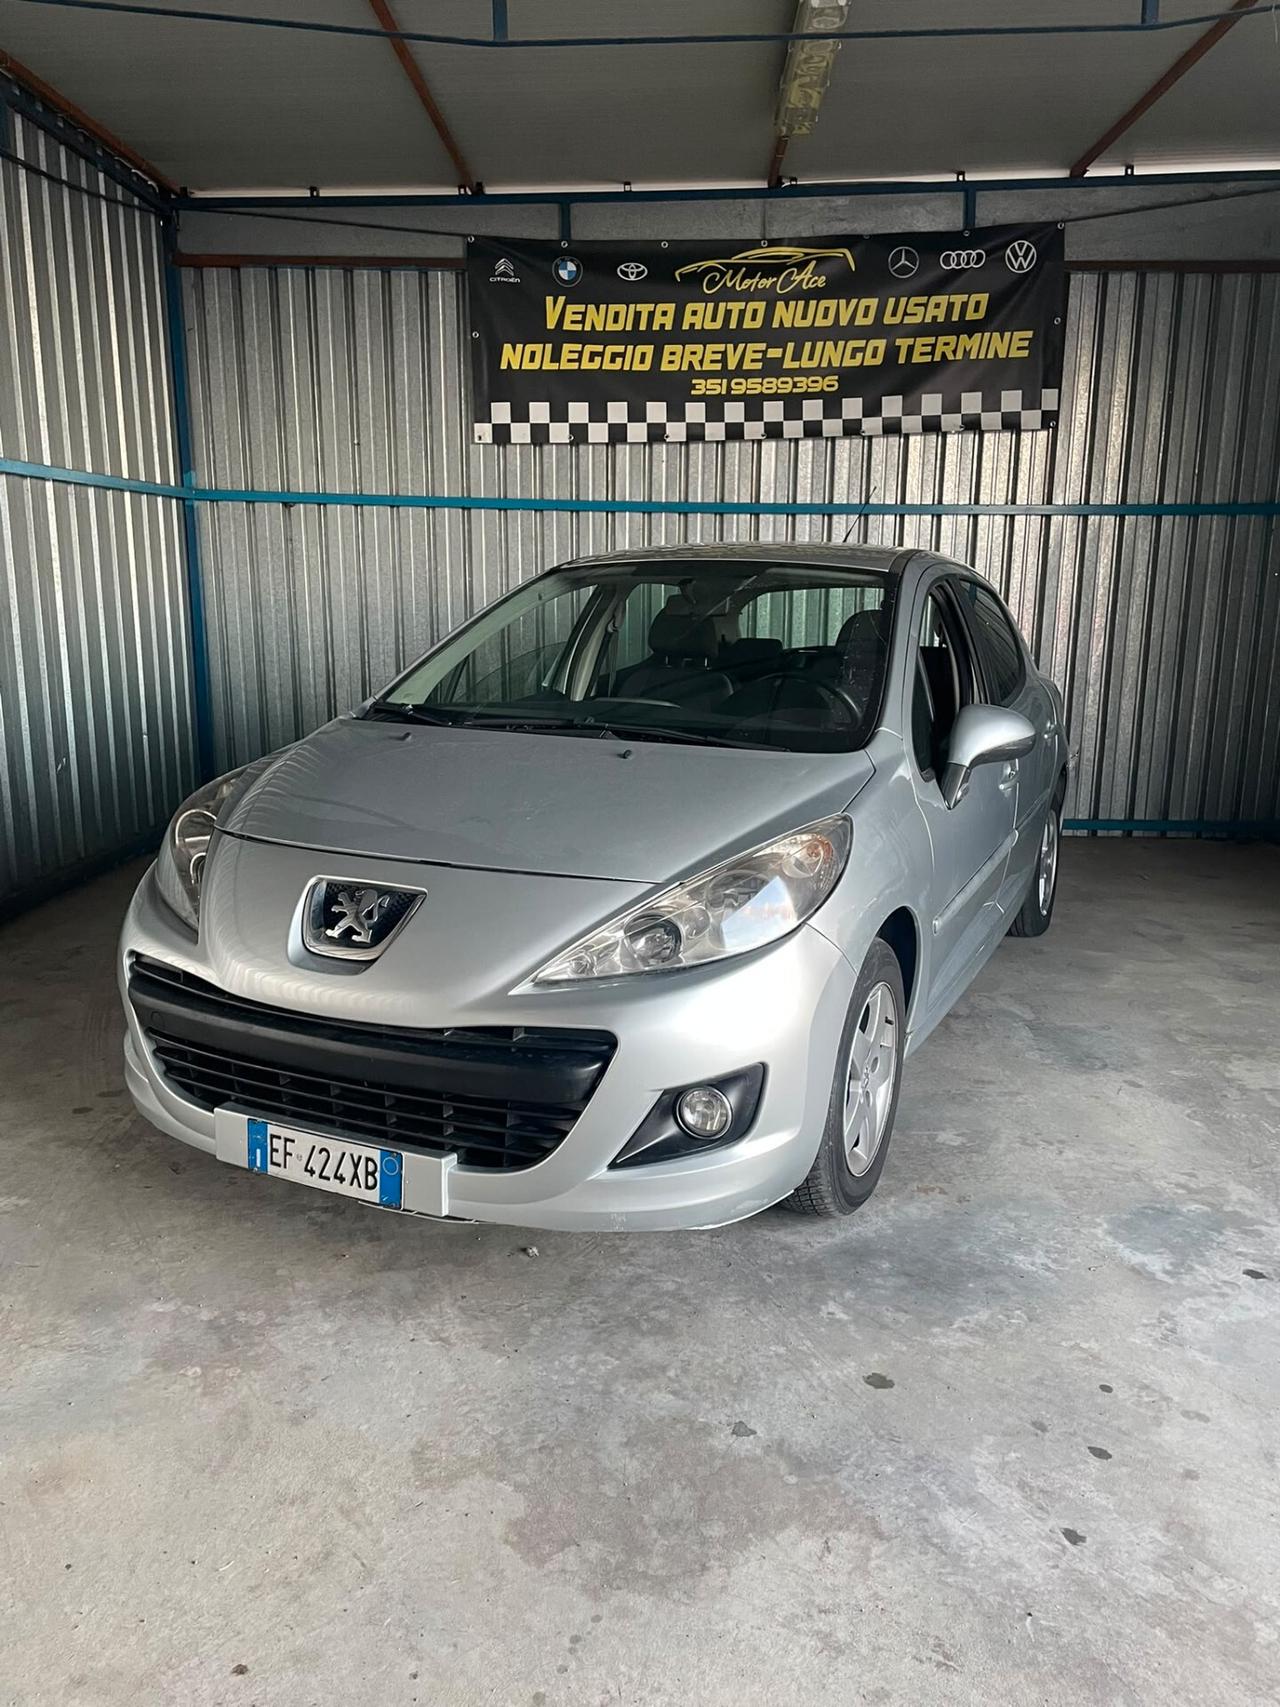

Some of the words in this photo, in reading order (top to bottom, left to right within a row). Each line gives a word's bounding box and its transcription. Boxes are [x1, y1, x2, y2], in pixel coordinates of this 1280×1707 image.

[702, 266, 777, 294] Motor
[776, 260, 827, 294] Ace
[545, 296, 676, 331] VENDITA
[682, 301, 766, 330] AUTO
[772, 298, 879, 329] NUOVO
[883, 293, 989, 325] USATO
[500, 343, 654, 371] NOLEGGIO
[660, 338, 887, 371] BREVE-LUNGO
[895, 330, 1034, 364] TERMINE
[730, 375, 839, 395] 9589396
[269, 1133, 296, 1169] EF
[303, 1144, 378, 1191] 424XB
